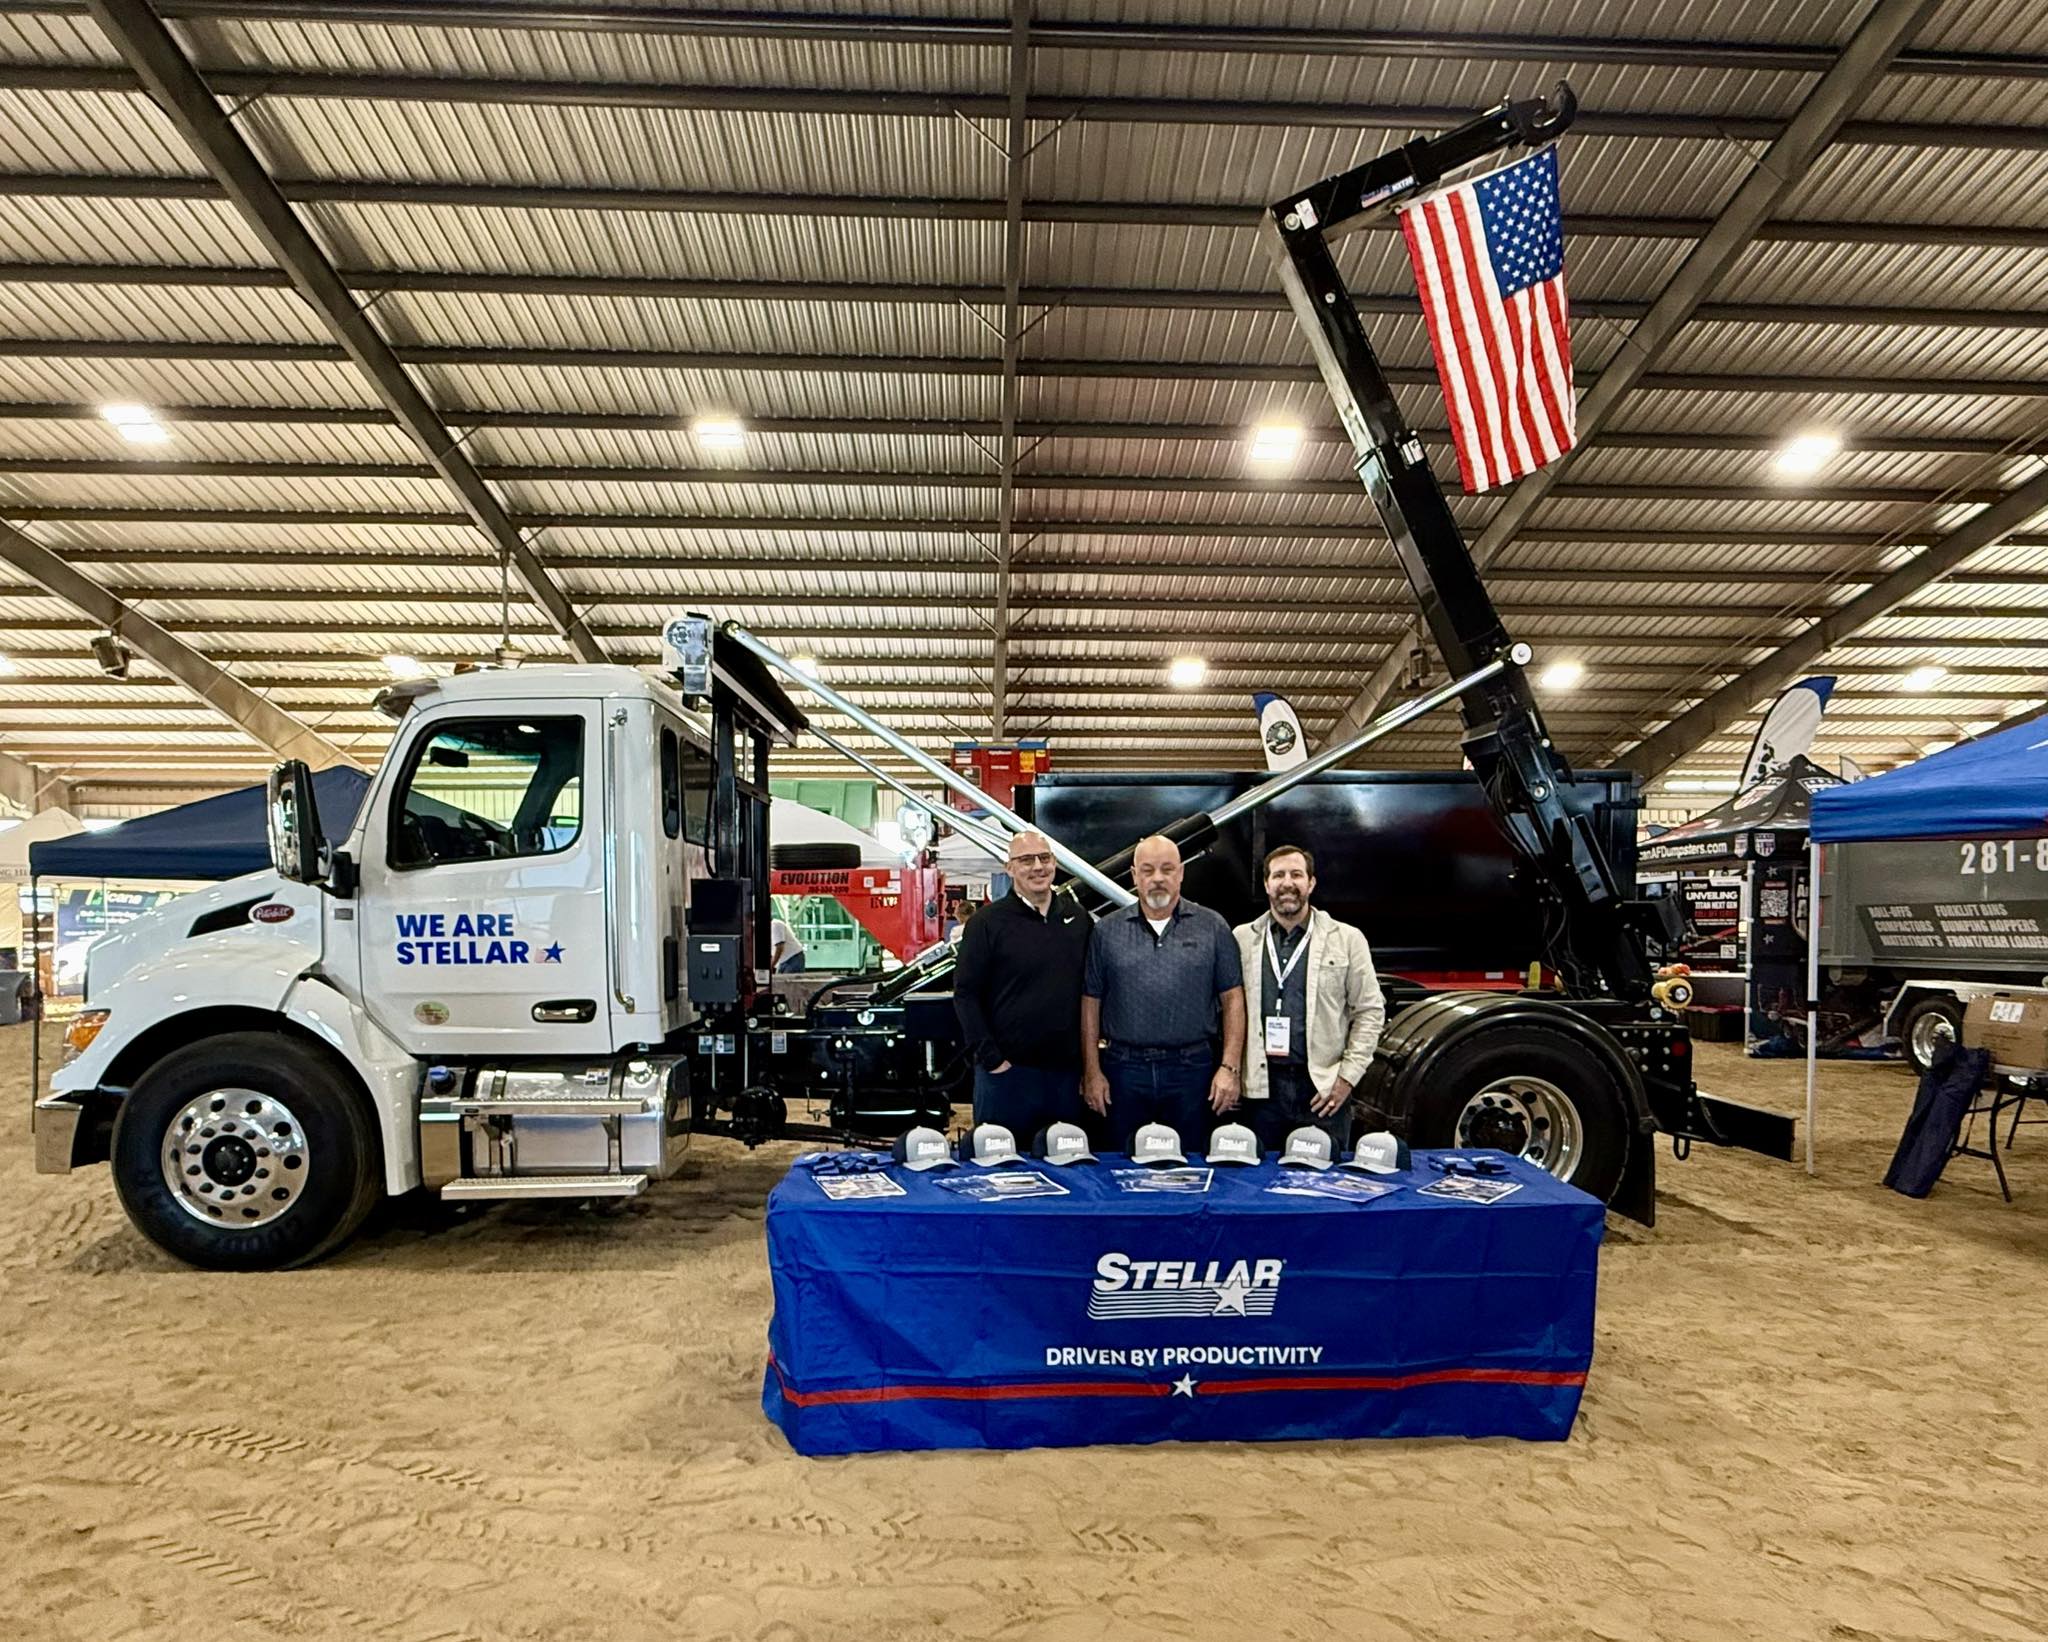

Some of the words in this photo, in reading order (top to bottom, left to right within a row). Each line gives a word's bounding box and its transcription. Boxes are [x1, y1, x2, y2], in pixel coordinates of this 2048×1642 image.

[780, 872, 849, 886] EVOLUTION
[1686, 891, 1738, 900] UNVEILING
[1868, 905, 1913, 918] ROLL-OFFS
[1934, 905, 1980, 917] FORKLIFT
[1980, 903, 2008, 916] BINS
[396, 914, 445, 937] WE
[452, 914, 514, 937] ARE
[1874, 920, 1935, 933] COMPACTORS
[1940, 920, 1989, 932] DUMPING
[1988, 919, 2039, 932] HOPPERS
[1946, 935, 2010, 948] FRONT/REAR
[396, 941, 530, 965] STELLAR
[1094, 1252, 1283, 1291] STELLAR
[1046, 1348, 1126, 1366] DRIVEN
[1130, 1349, 1157, 1366] BY
[1163, 1346, 1323, 1364] PRODUCTIVITY
